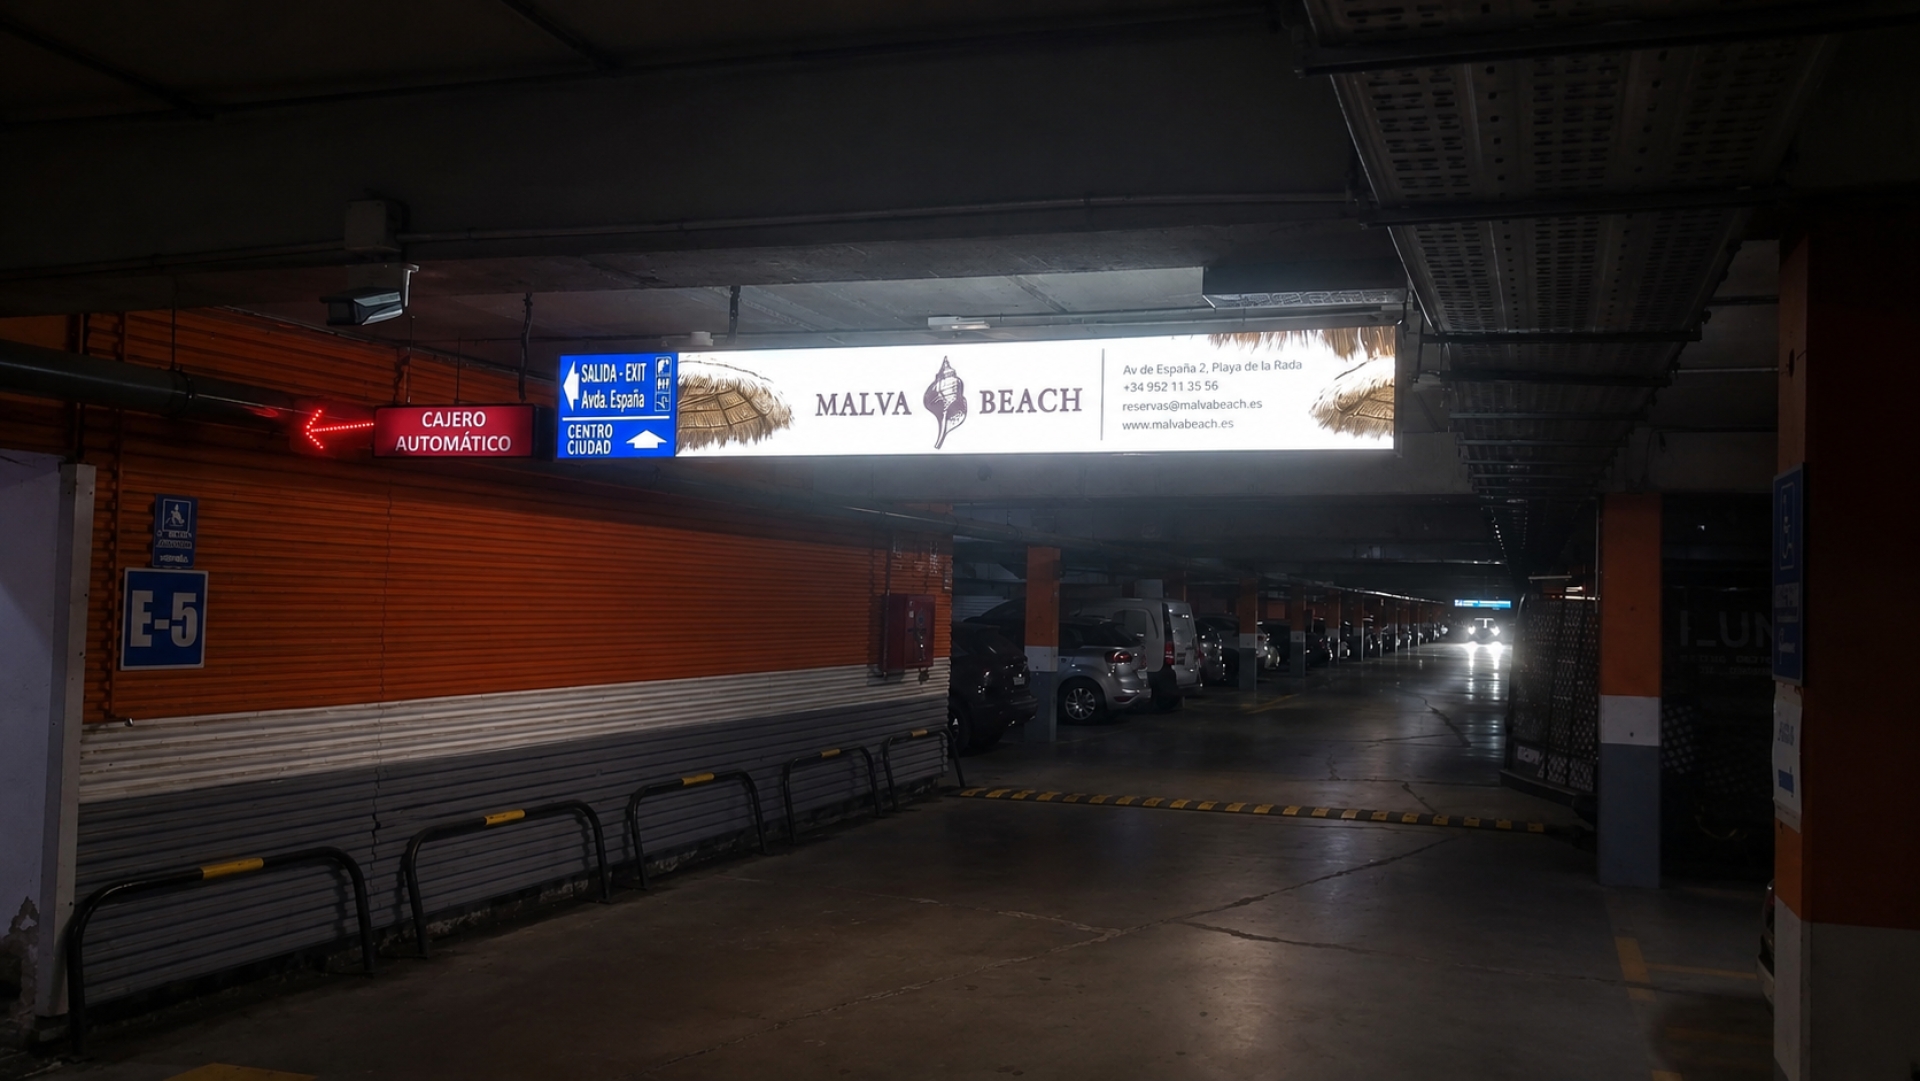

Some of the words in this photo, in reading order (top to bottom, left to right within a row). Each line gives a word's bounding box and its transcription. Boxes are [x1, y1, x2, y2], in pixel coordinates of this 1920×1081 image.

[581, 363, 617, 383] SALIDA
[625, 362, 647, 382] EXIT
[1122, 365, 1138, 376] Av
[1140, 364, 1154, 375] de
[1156, 363, 1197, 377] España
[1199, 362, 1209, 376] 2,
[1212, 362, 1242, 374] Playa
[1244, 361, 1258, 372] de
[1261, 360, 1271, 371] la
[1274, 360, 1303, 371] Rada
[1123, 382, 1144, 393] +34
[1146, 381, 1168, 392] 952
[1172, 381, 1184, 392] 11
[1187, 381, 1202, 392] 35
[1204, 380, 1219, 391] 56
[581, 389, 608, 409] Avda.
[610, 389, 645, 413] España
[815, 391, 912, 416] MALVA
[979, 388, 1083, 414] BEACH
[1122, 399, 1263, 412] reservas@malvabeach.es
[422, 411, 487, 428] CAJERO
[1122, 419, 1234, 430] www.malvabeach.es
[567, 423, 613, 439] CENTRO
[395, 431, 512, 452] AUTOMÁTICO
[567, 440, 612, 455] CIUDAD
[130, 589, 199, 648] E-5
